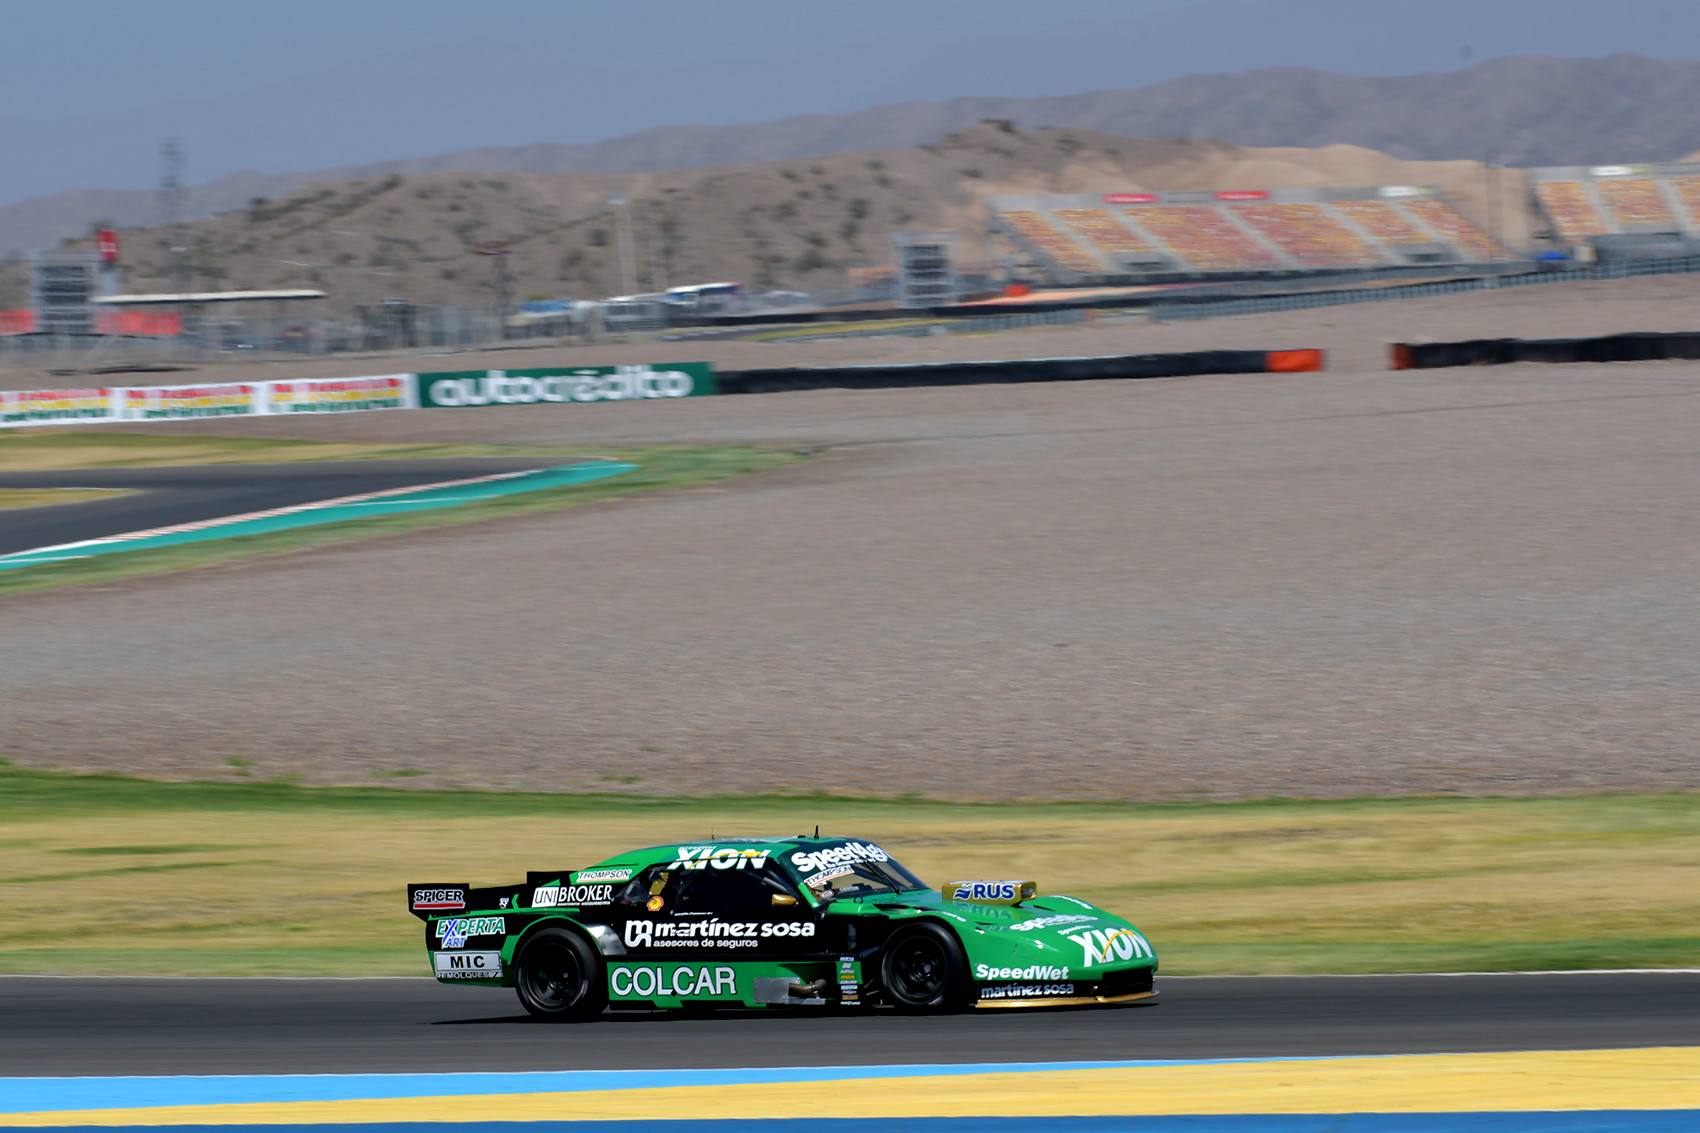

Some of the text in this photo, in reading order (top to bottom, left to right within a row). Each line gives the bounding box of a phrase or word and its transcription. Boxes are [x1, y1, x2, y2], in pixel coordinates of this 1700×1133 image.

[667, 846, 772, 870] XION
[579, 869, 631, 880] THOMPSON
[414, 889, 464, 903] SPICER
[972, 883, 1015, 900] RUS
[436, 917, 505, 939] EXPERTA
[655, 918, 816, 937] martínez sosa
[446, 937, 466, 948] ART
[653, 937, 758, 949] asesores de seguros
[1067, 928, 1153, 968] XION
[450, 955, 485, 968] MIC
[976, 963, 1069, 980] SpeedWet
[611, 966, 737, 996] COLCAR
[981, 982, 1074, 998] martínez sosa
